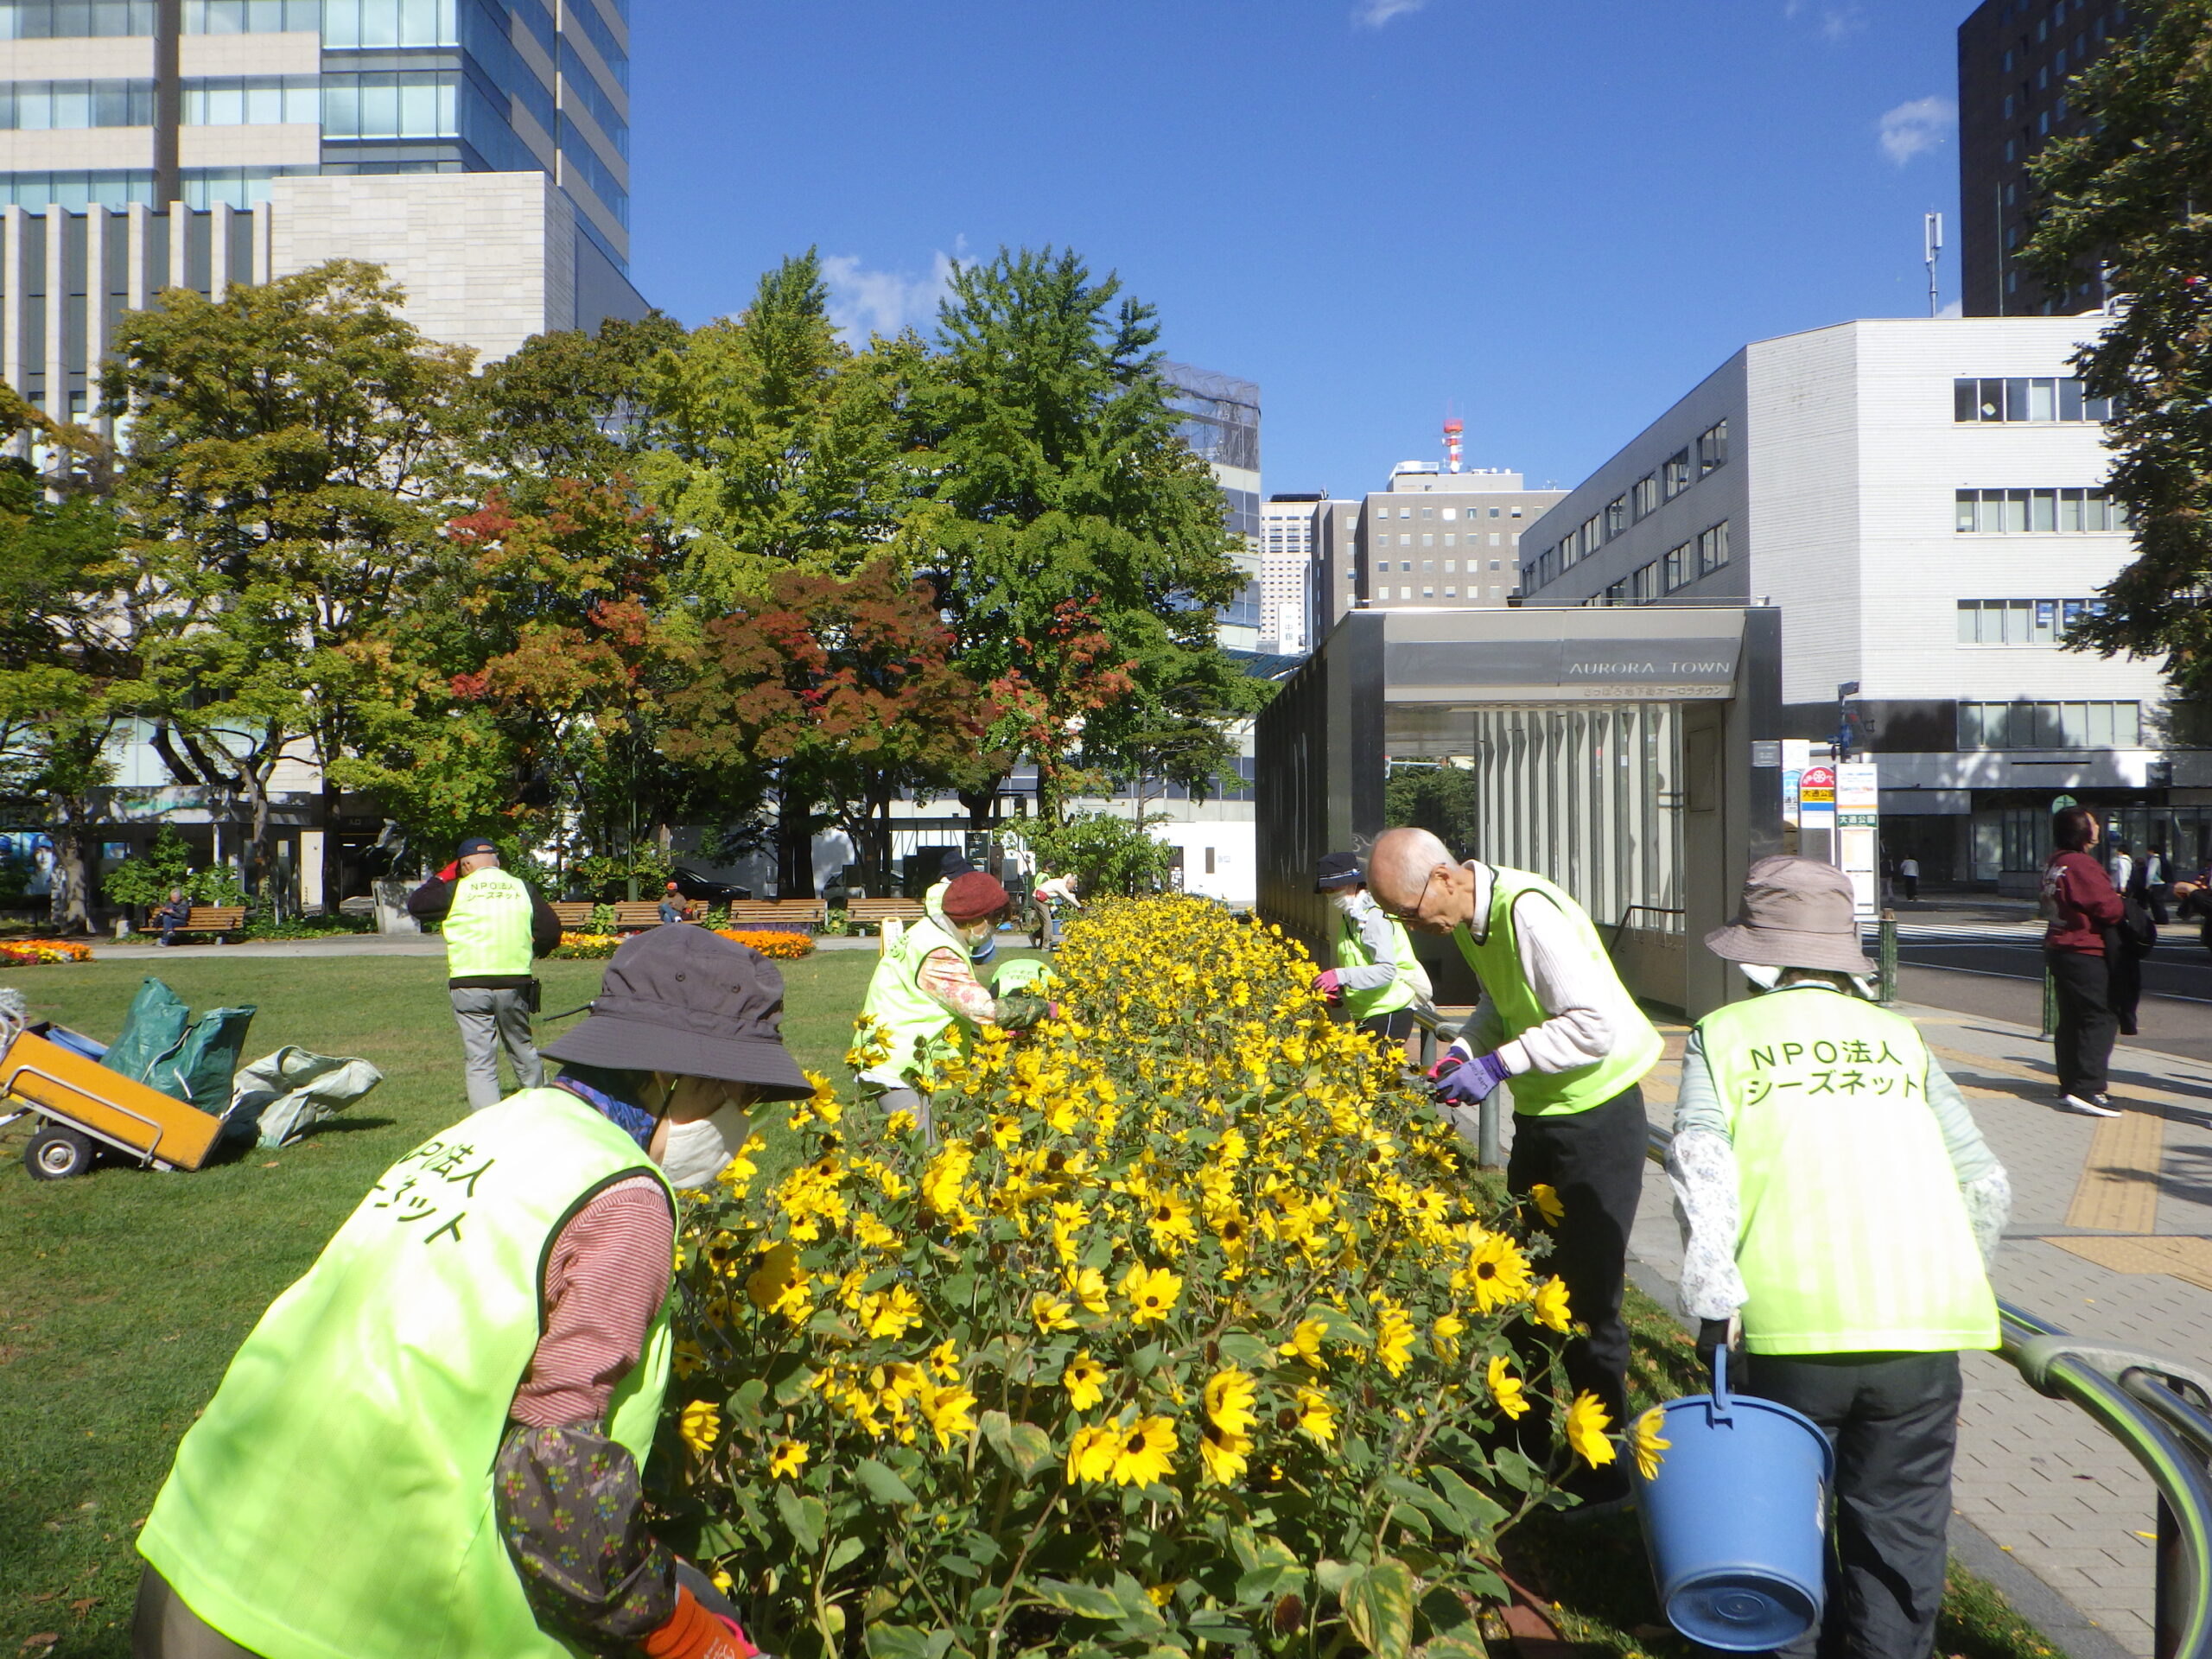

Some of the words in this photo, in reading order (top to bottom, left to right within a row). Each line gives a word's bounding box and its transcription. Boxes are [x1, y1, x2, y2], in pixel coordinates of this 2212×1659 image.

[1569, 662, 1655, 675] AURORA
[1671, 661, 1730, 673] TOWN
[1750, 1039, 1904, 1071] NPO法人
[1746, 1069, 1918, 1107] シーズネット
